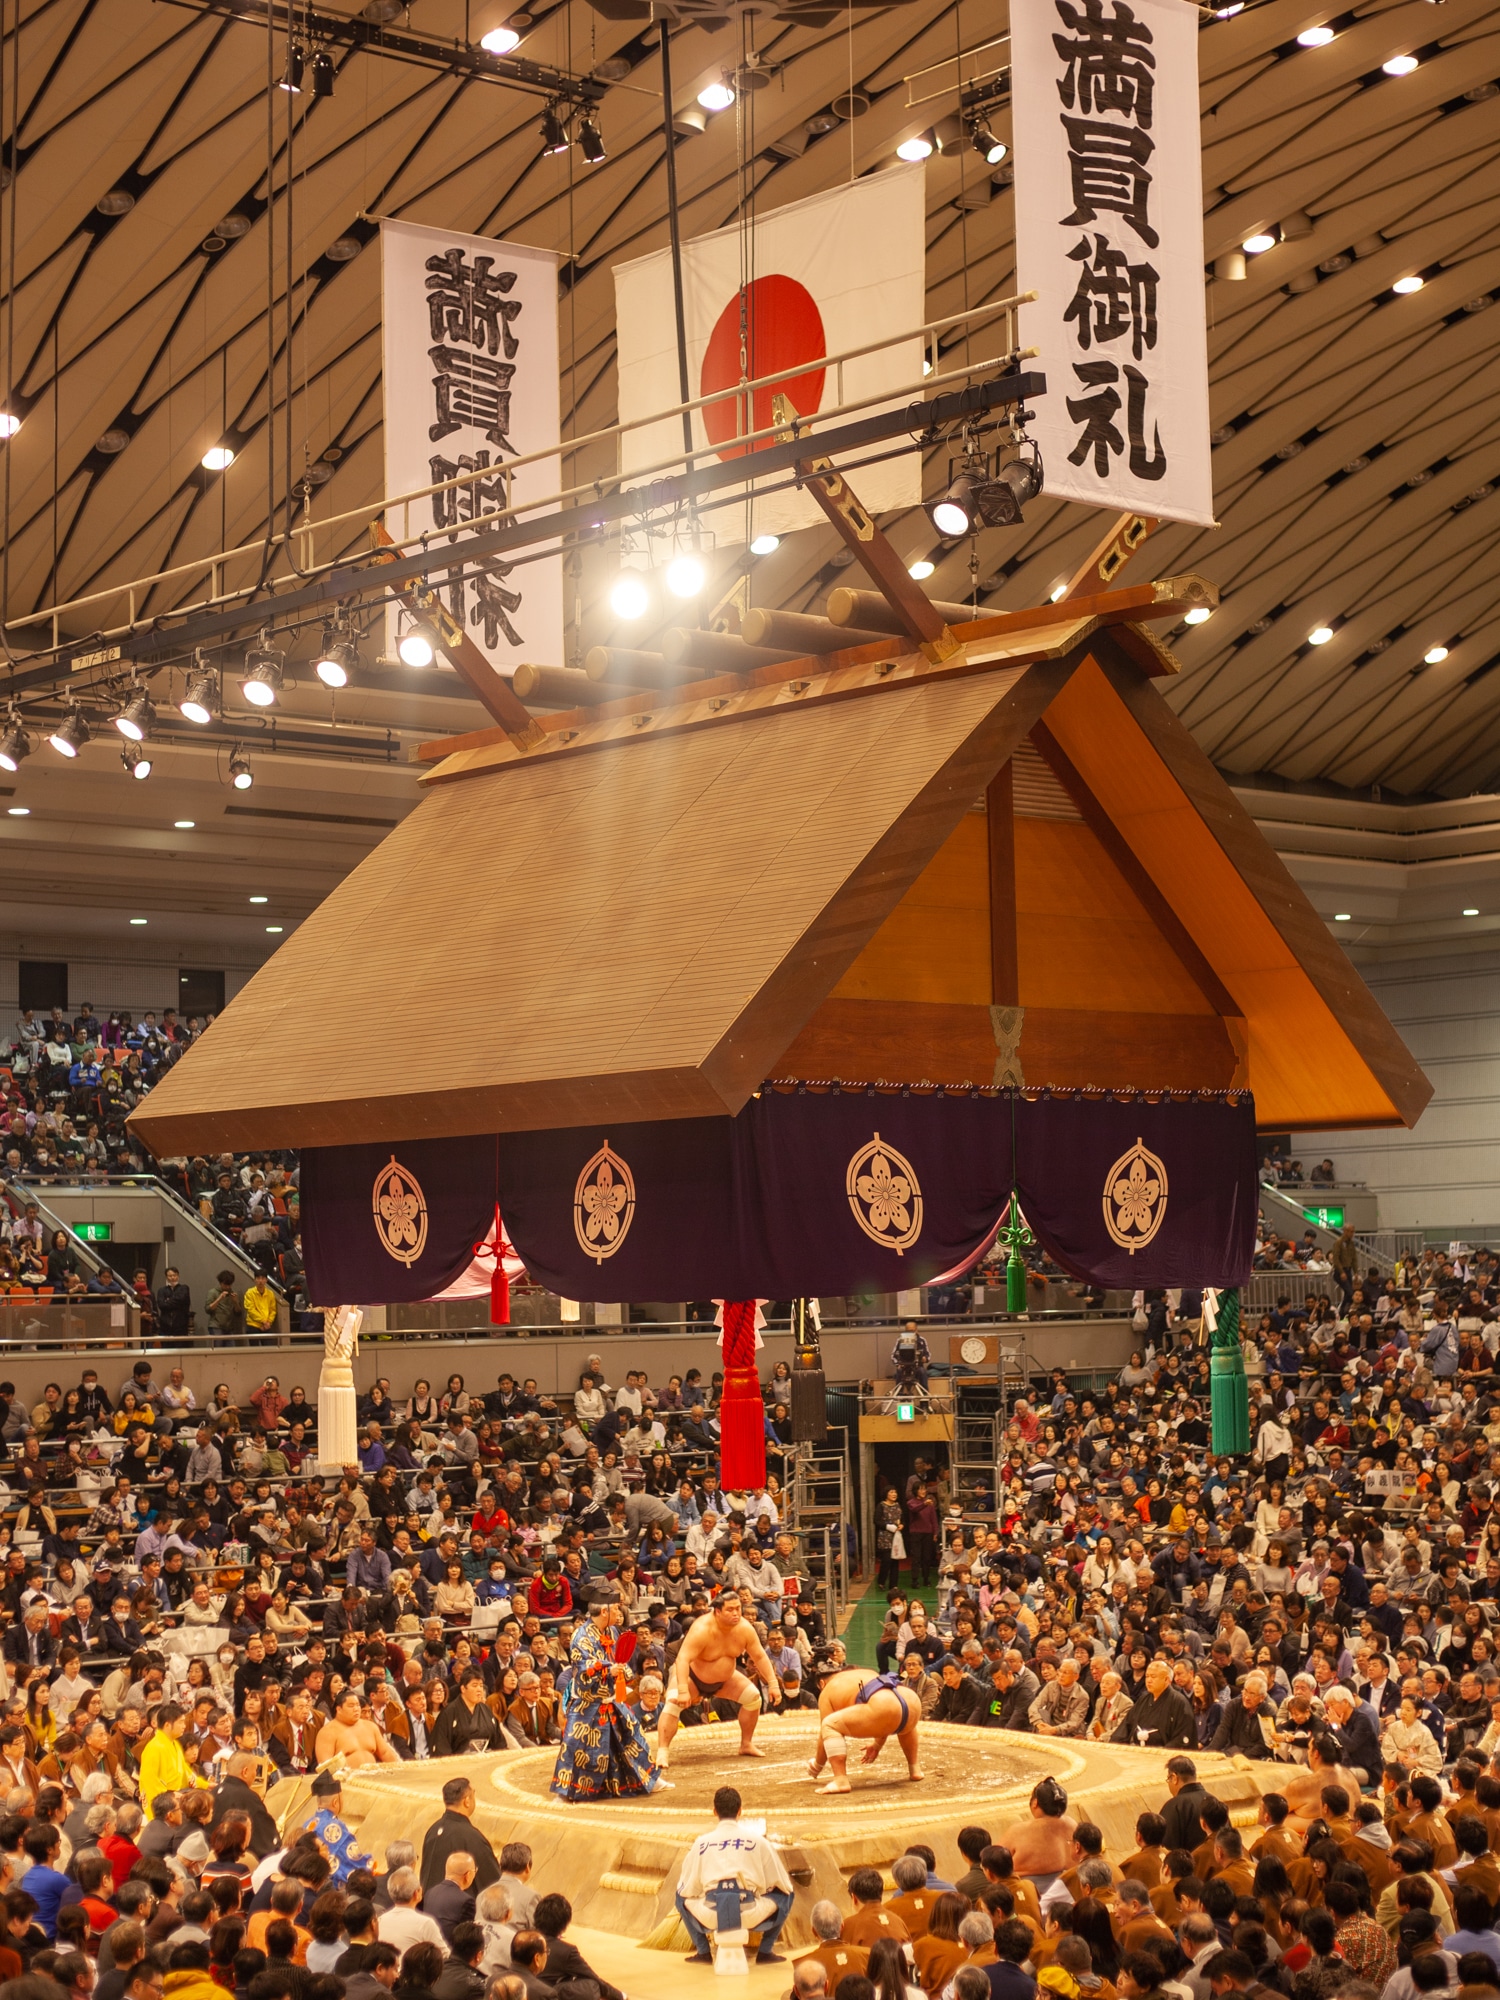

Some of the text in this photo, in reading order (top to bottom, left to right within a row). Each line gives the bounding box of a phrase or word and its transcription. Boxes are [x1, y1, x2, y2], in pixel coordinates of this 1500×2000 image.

[1052, 0, 1167, 481] 満員御礼
[699, 1838, 757, 1856] シーチキン
